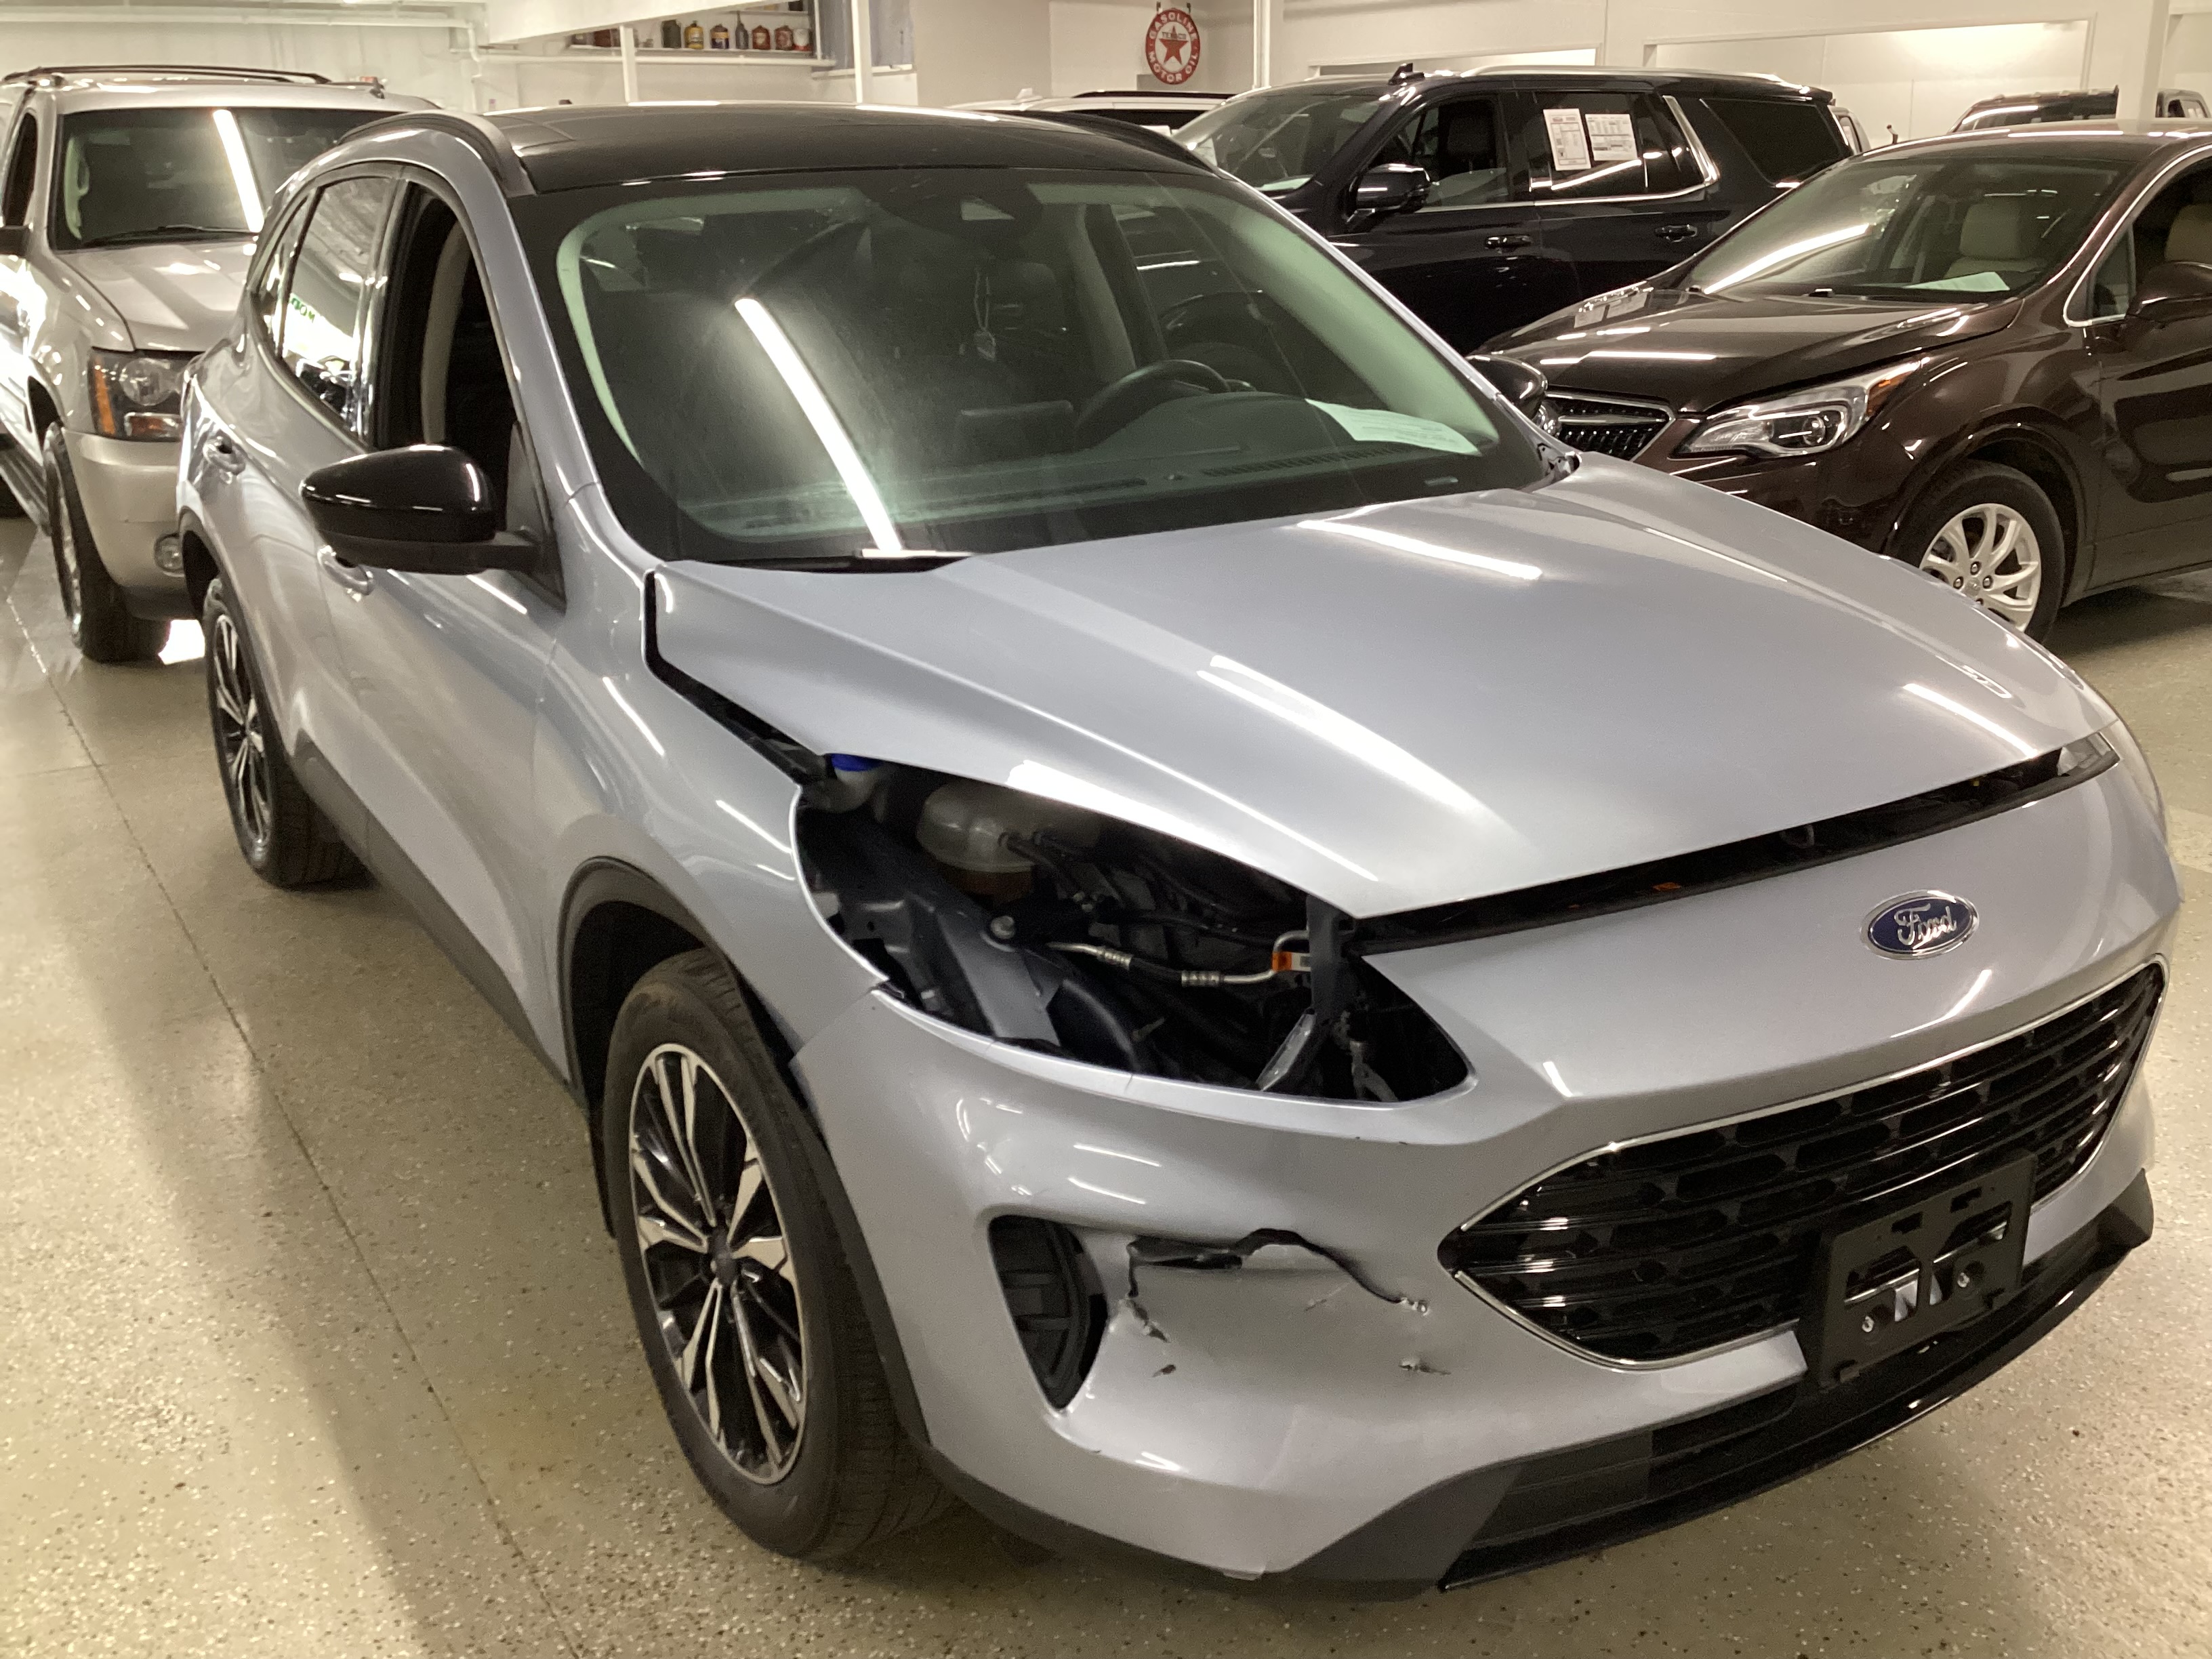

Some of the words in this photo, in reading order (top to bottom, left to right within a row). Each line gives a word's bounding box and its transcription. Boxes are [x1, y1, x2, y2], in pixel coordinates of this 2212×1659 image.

[1149, 12, 1197, 40] GASOLINE
[1162, 32, 1187, 40] TECO
[1149, 51, 1183, 83] MOTOR
[1185, 53, 1197, 74] OIL
[1894, 903, 1957, 949] Ford
